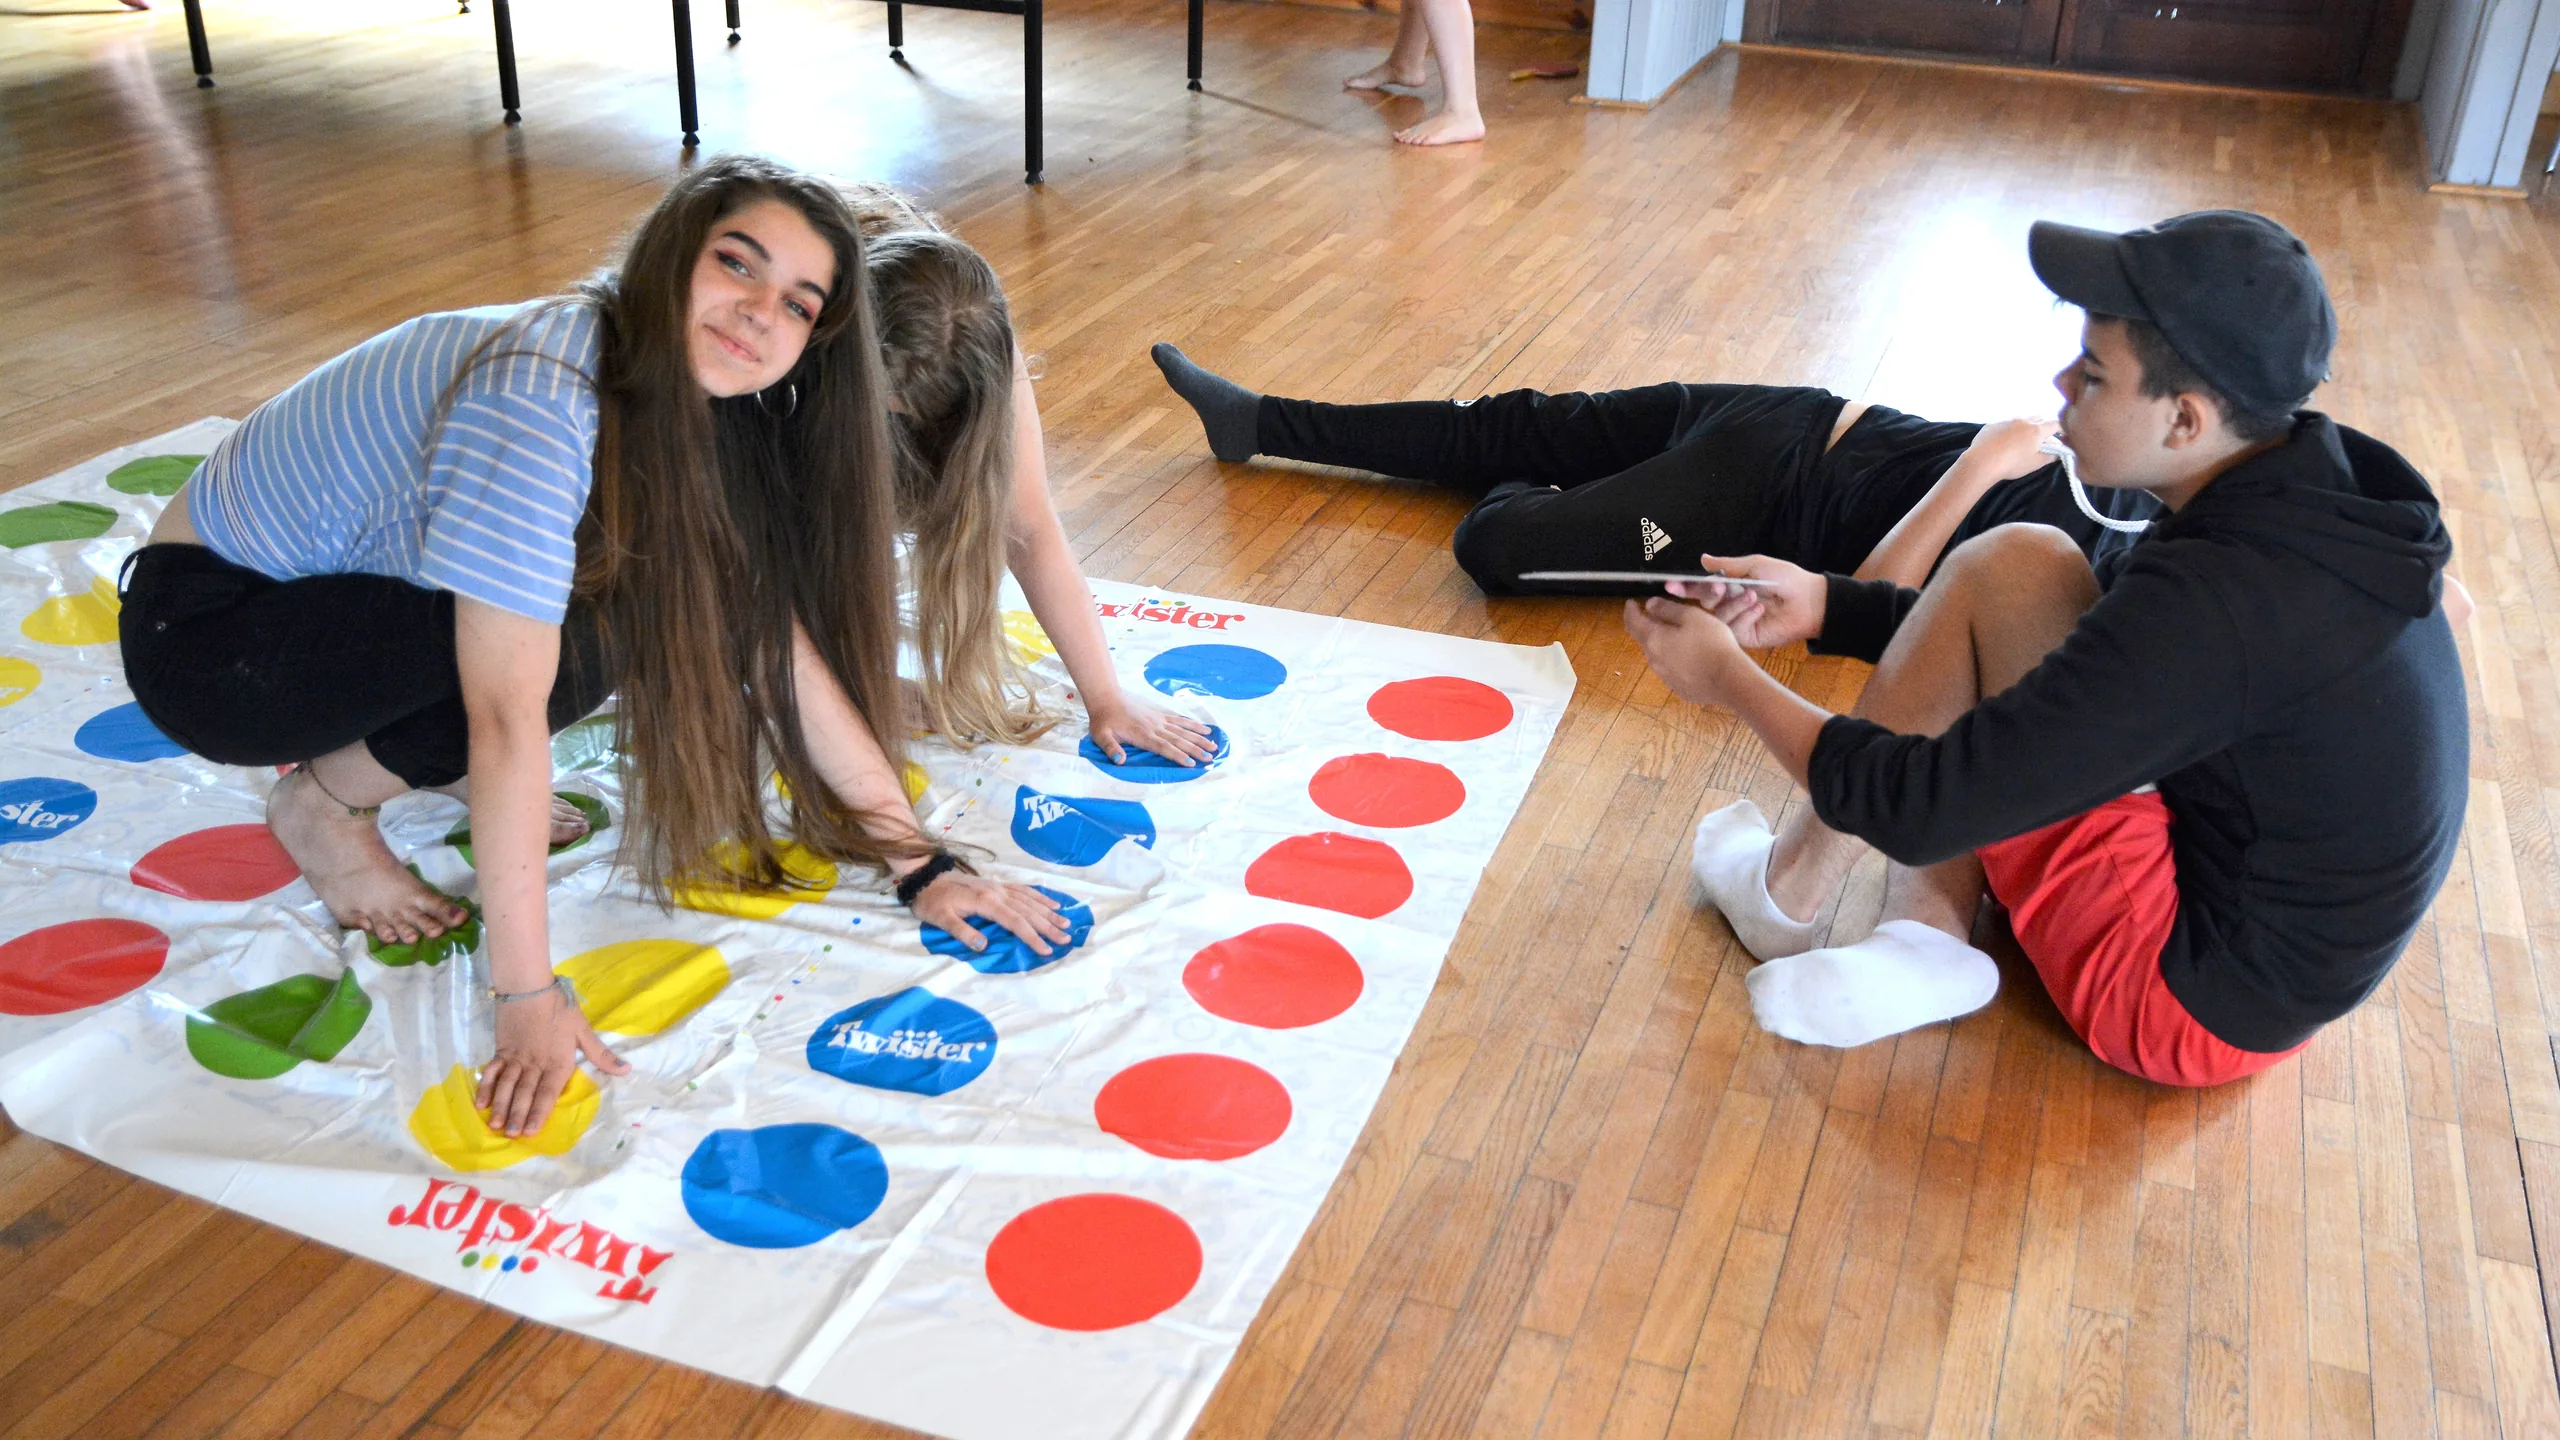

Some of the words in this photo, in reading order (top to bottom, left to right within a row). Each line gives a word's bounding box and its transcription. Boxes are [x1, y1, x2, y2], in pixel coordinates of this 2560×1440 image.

[1640, 517, 1654, 561] adidas
[1092, 595, 1246, 631] wister
[0, 800, 80, 829] ster
[827, 1020, 987, 1063] Twister
[387, 1176, 675, 1305] Twister
